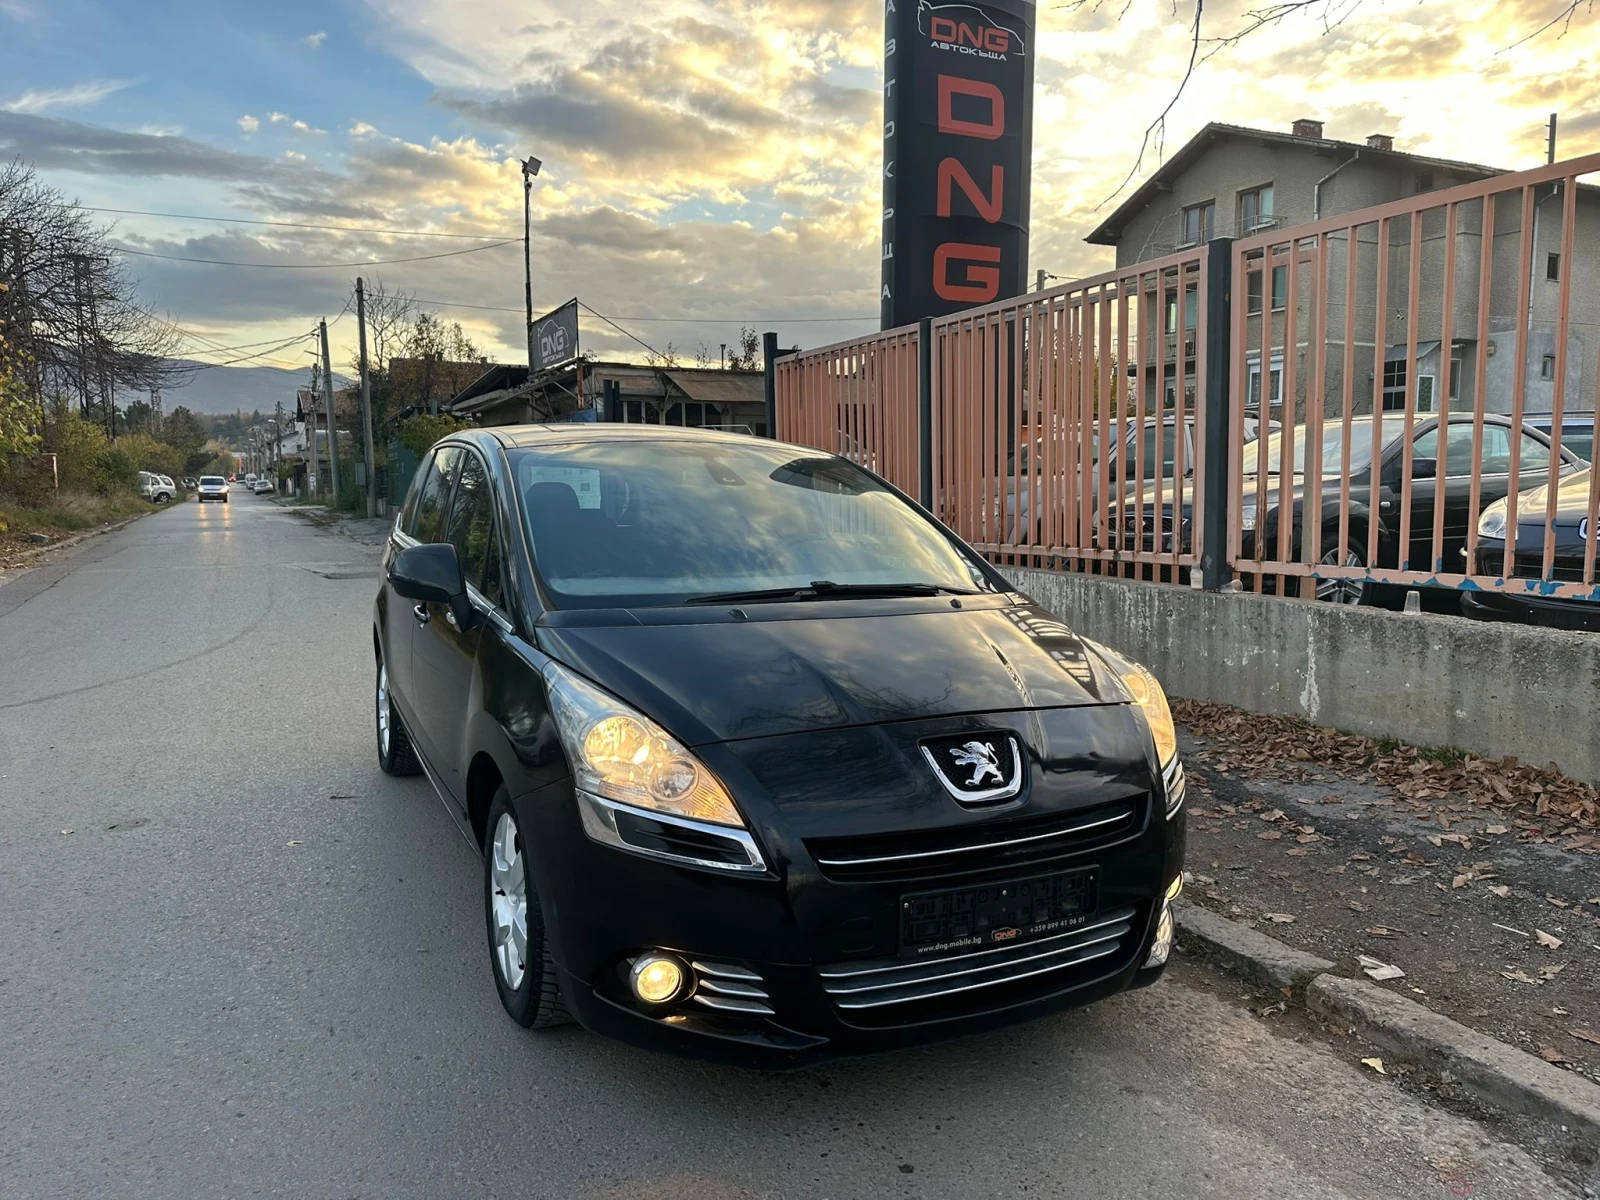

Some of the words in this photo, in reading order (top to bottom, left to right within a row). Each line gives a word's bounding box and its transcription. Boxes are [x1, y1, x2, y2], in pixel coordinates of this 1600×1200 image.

[931, 16, 1009, 53] DNG
[930, 40, 1007, 61] АВТОКЪША
[933, 74, 1005, 303] DNG
[541, 329, 564, 357] DNG
[1030, 924, 1046, 933] +359
[1060, 919, 1068, 927] 41
[917, 936, 982, 953] www.dng.mobile.bg
